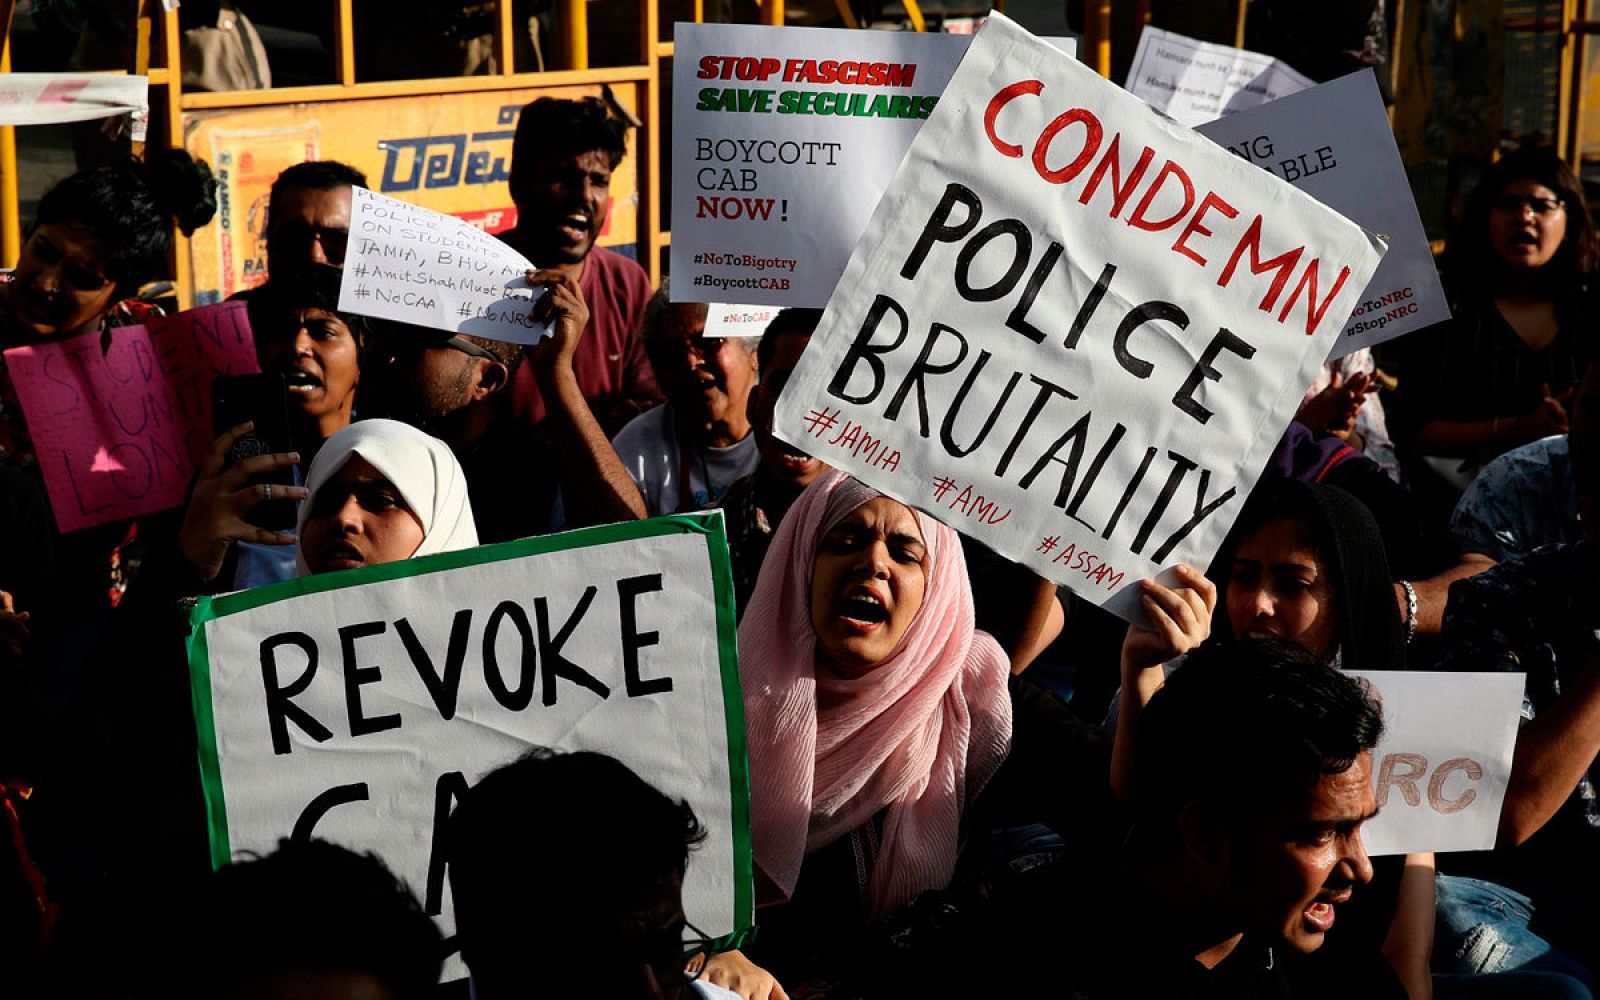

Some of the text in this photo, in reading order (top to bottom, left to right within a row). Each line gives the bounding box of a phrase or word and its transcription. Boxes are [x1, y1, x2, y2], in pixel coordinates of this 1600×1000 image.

[696, 55, 917, 87] STOP FASCISM
[695, 87, 940, 120] SAVE SECULARIS
[695, 138, 841, 166] BOYCOTT
[1227, 135, 1274, 163] NG
[696, 168, 758, 192] CAB
[361, 203, 439, 230] POLICE
[983, 79, 1352, 336] CONDEMN
[362, 220, 392, 236] ON
[694, 252, 797, 272] #NoToBigotry
[353, 283, 437, 310] #NoCAA
[694, 274, 790, 290] #BoycottCAB
[900, 183, 1257, 425] POLICE
[1351, 287, 1414, 317] oToNRC
[1346, 303, 1418, 337] #StopNRC
[804, 407, 901, 472] #JAMIA
[827, 295, 1237, 565] BRUTALITY
[933, 476, 1012, 526] #AMU
[1036, 535, 1125, 590] #ASSAM
[260, 573, 673, 755] REVOKE
[1375, 752, 1484, 834] RC
